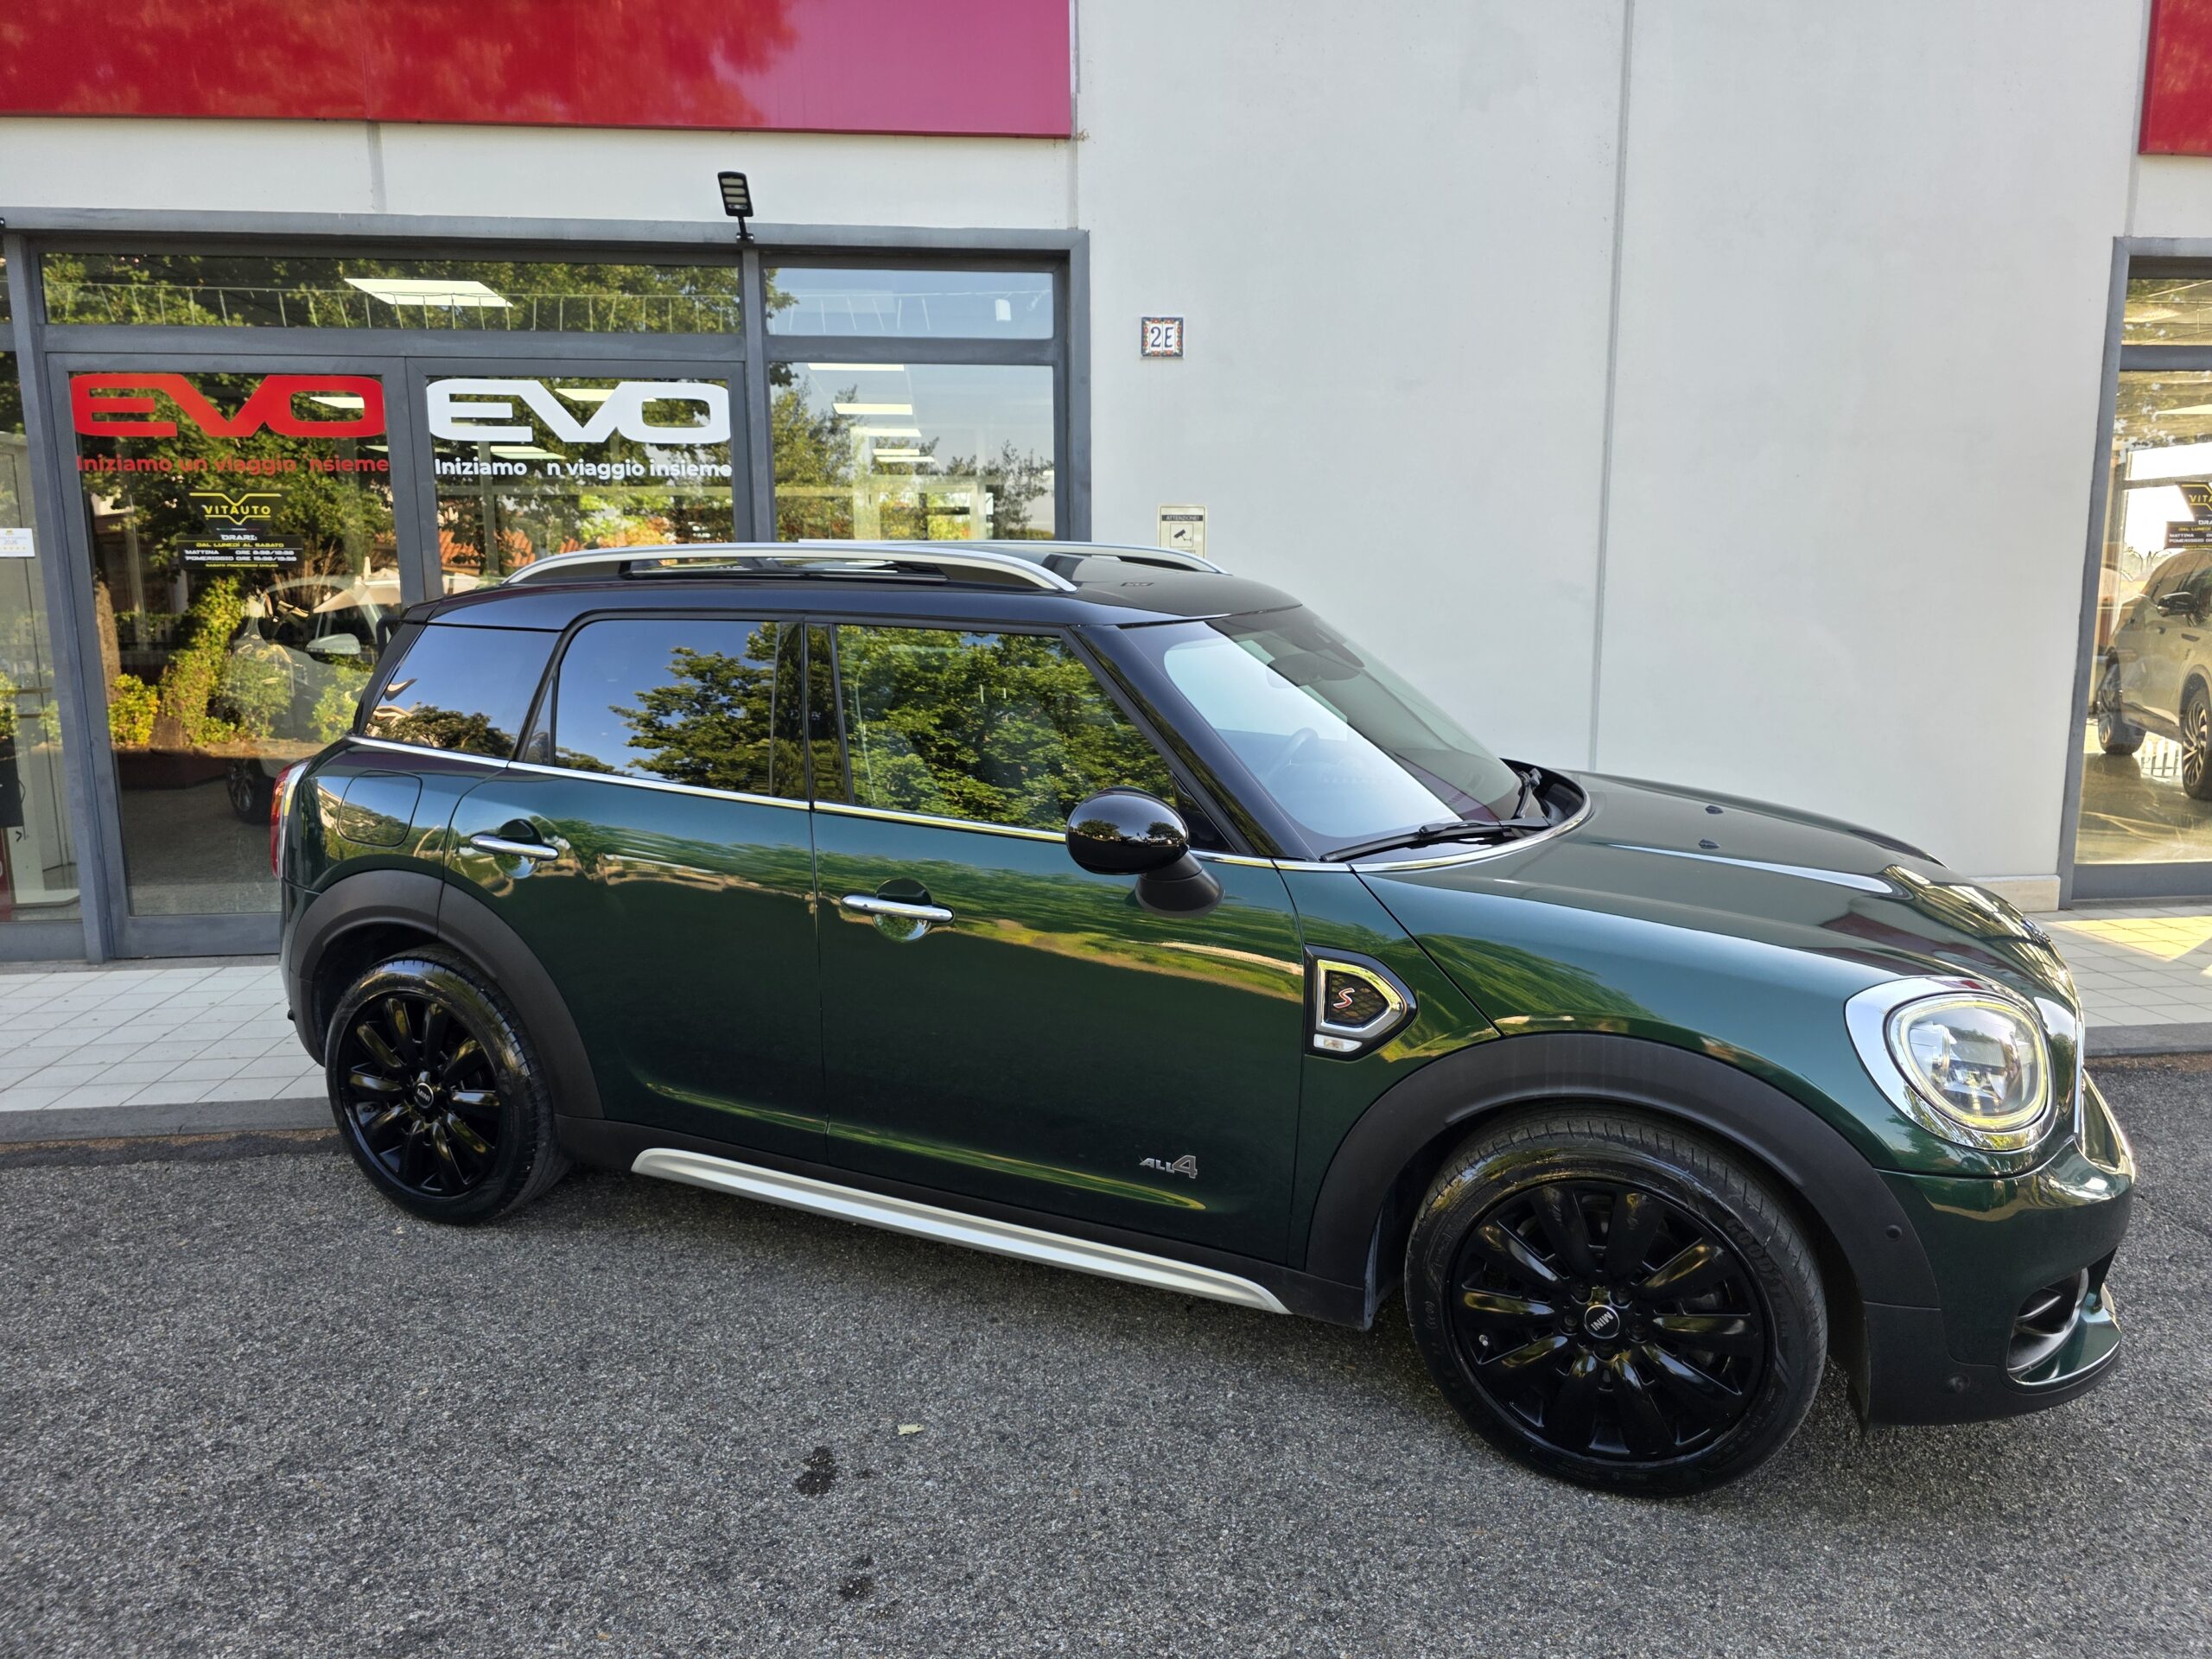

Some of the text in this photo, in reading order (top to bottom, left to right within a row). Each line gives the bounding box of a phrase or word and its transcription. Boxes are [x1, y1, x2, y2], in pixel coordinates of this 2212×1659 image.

[1150, 326, 1174, 348] 2E
[70, 372, 386, 438] EVO
[426, 378, 731, 444] EVO
[76, 453, 390, 476] Iniziamo un viaggio nsieme
[435, 456, 528, 476] Iniziamo
[565, 458, 645, 480] viaggio
[649, 457, 733, 477] insieme
[202, 505, 271, 515] VITAUTO
[1333, 988, 1356, 1009] S
[1139, 1154, 1198, 1179] ALL4
[1590, 1311, 1614, 1331] MINI
